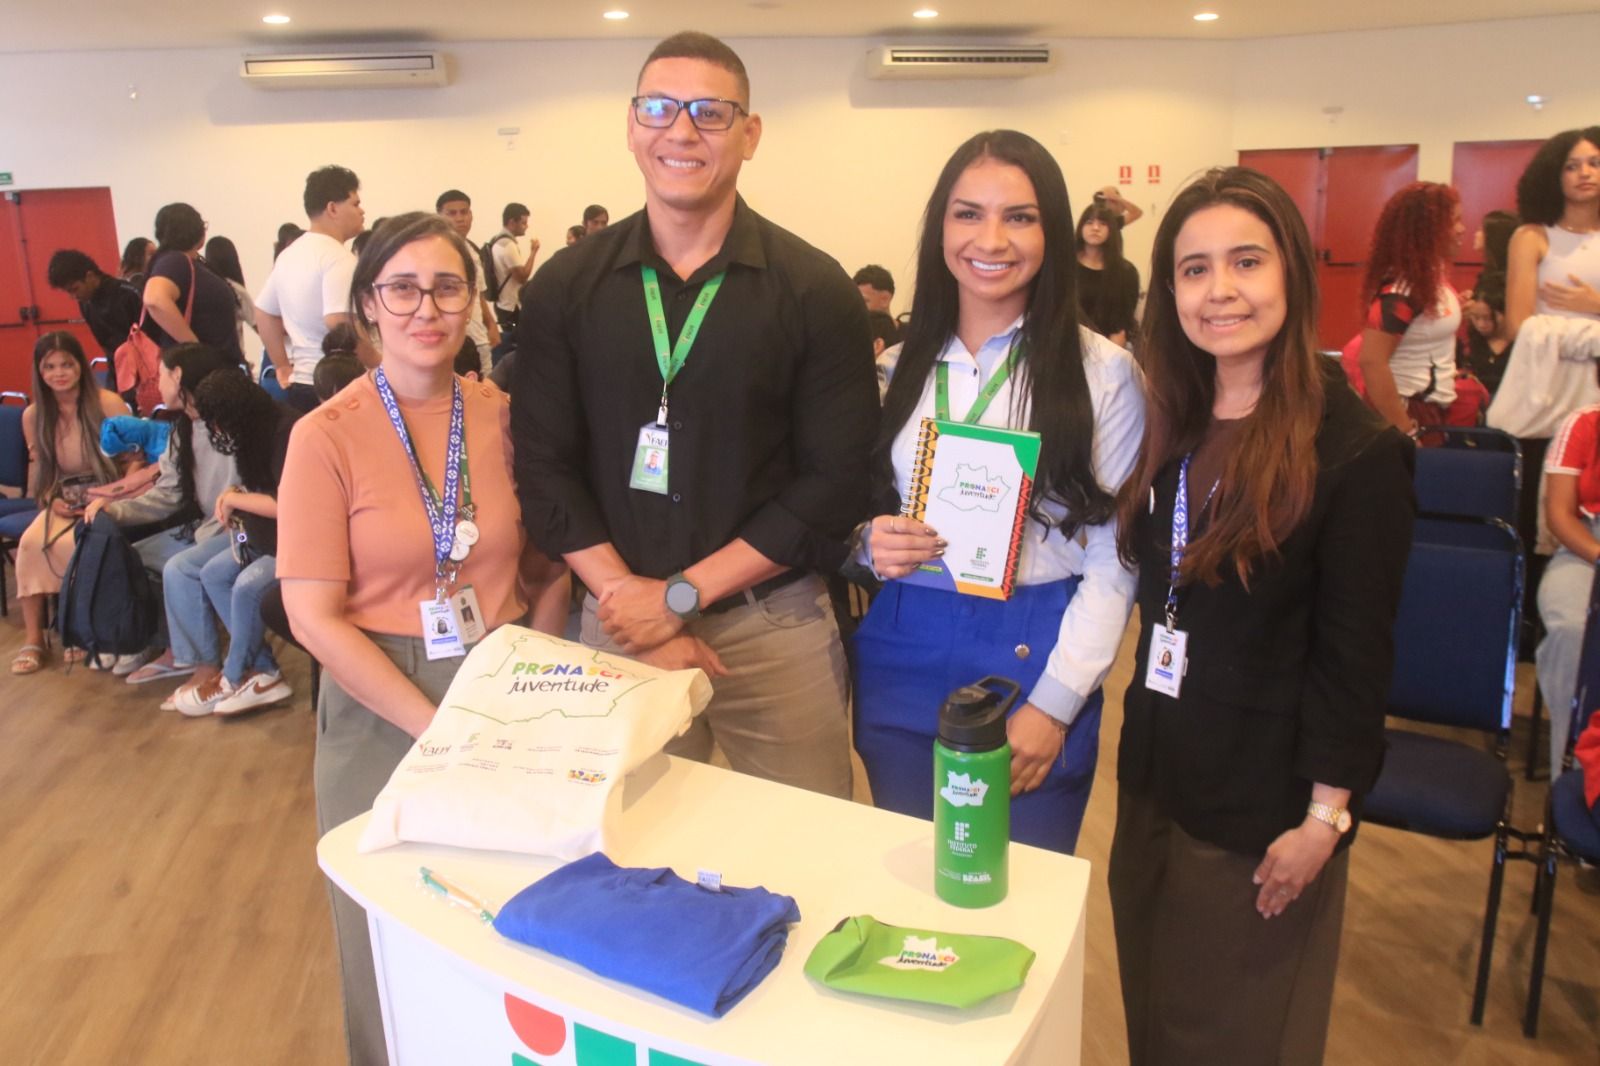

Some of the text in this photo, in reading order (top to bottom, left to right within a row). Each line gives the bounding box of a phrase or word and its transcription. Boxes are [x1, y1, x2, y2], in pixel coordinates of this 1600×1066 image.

[959, 481, 1000, 494] PRONASCI
[511, 662, 623, 679] PRONASCI
[507, 676, 609, 695] juventude
[902, 950, 955, 962] PRONASCI
